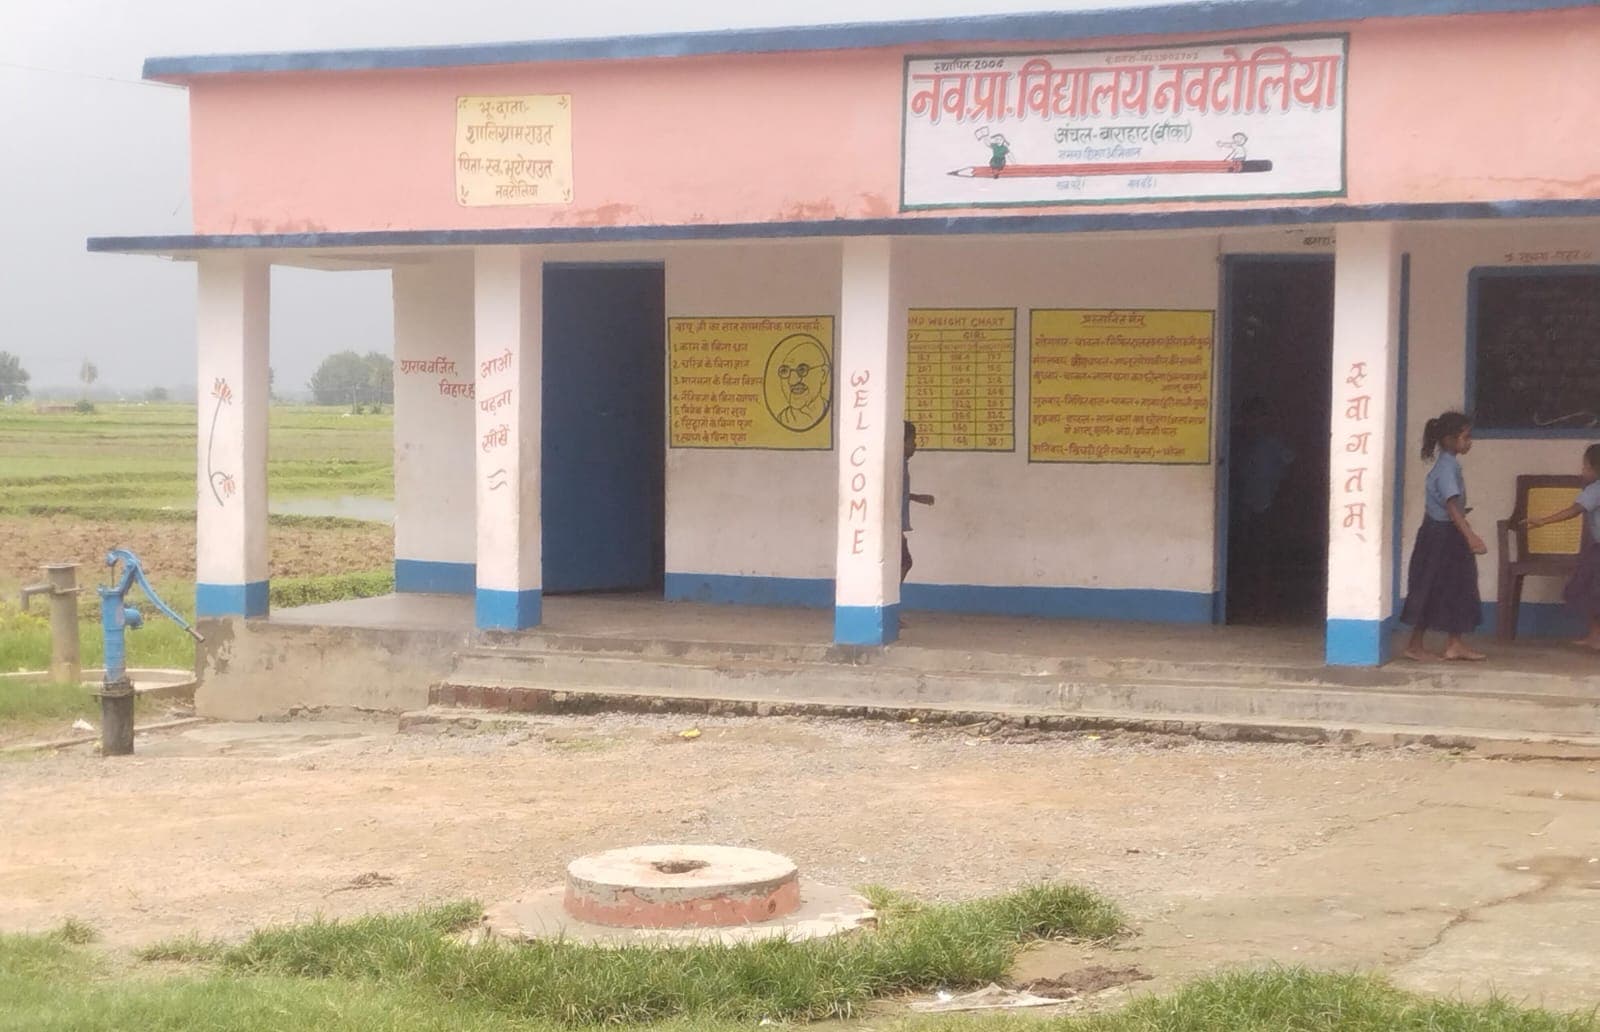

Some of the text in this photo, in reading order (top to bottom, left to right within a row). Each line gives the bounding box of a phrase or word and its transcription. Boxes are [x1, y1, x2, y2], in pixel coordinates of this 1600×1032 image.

[1154, 47, 1341, 114] नवटोलिया
[929, 316, 967, 327] WEIGHT
[970, 317, 1005, 328] CHART
